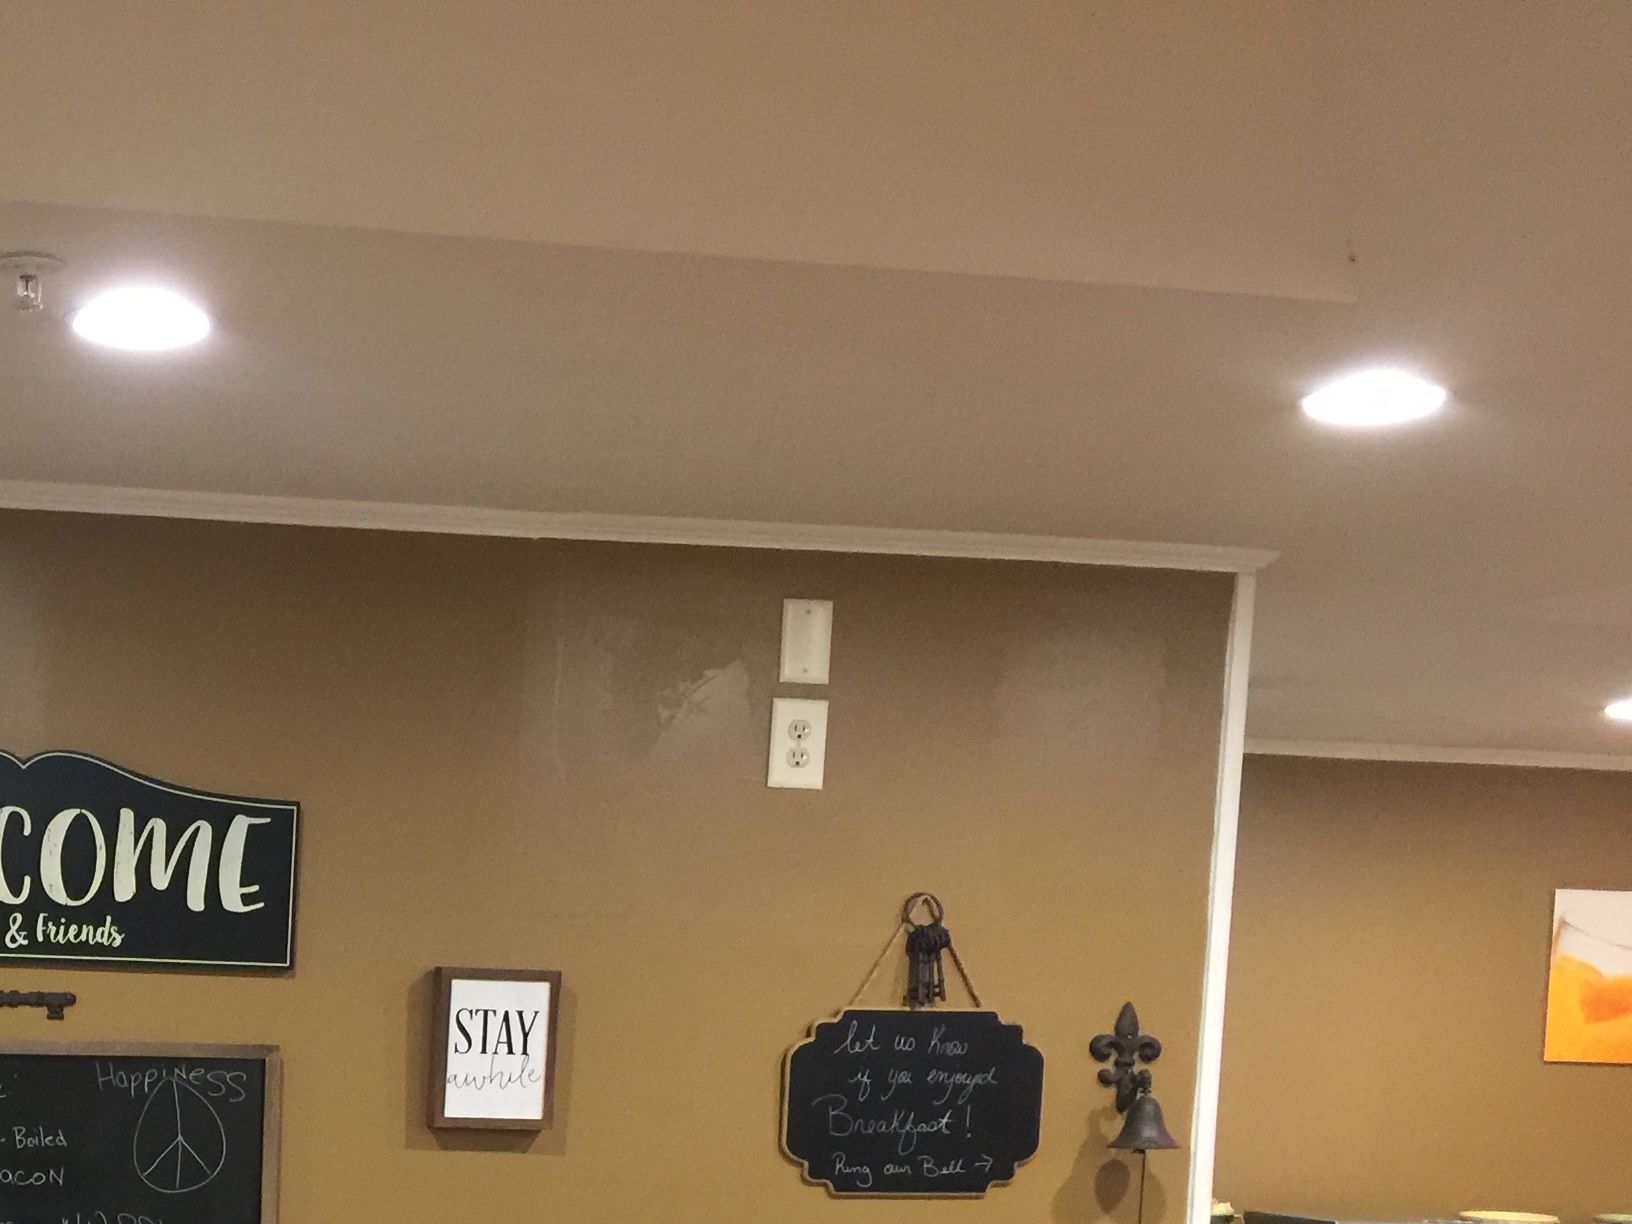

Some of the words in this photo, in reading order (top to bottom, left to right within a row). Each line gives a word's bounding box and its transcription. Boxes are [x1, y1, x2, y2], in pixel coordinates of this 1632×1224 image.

[5, 912, 29, 949] &
[35, 913, 126, 948] Friends
[454, 1008, 540, 1056] STAY
[894, 1034, 916, 1051] us
[447, 1055, 541, 1090] awhile
[848, 1067, 872, 1102] if
[880, 1068, 913, 1101] you
[926, 1067, 998, 1105] enjoyed
[13, 1126, 68, 1149] Boiled
[832, 1151, 872, 1188] Ring
[883, 1162, 912, 1175] our
[917, 1155, 967, 1177] Bell
